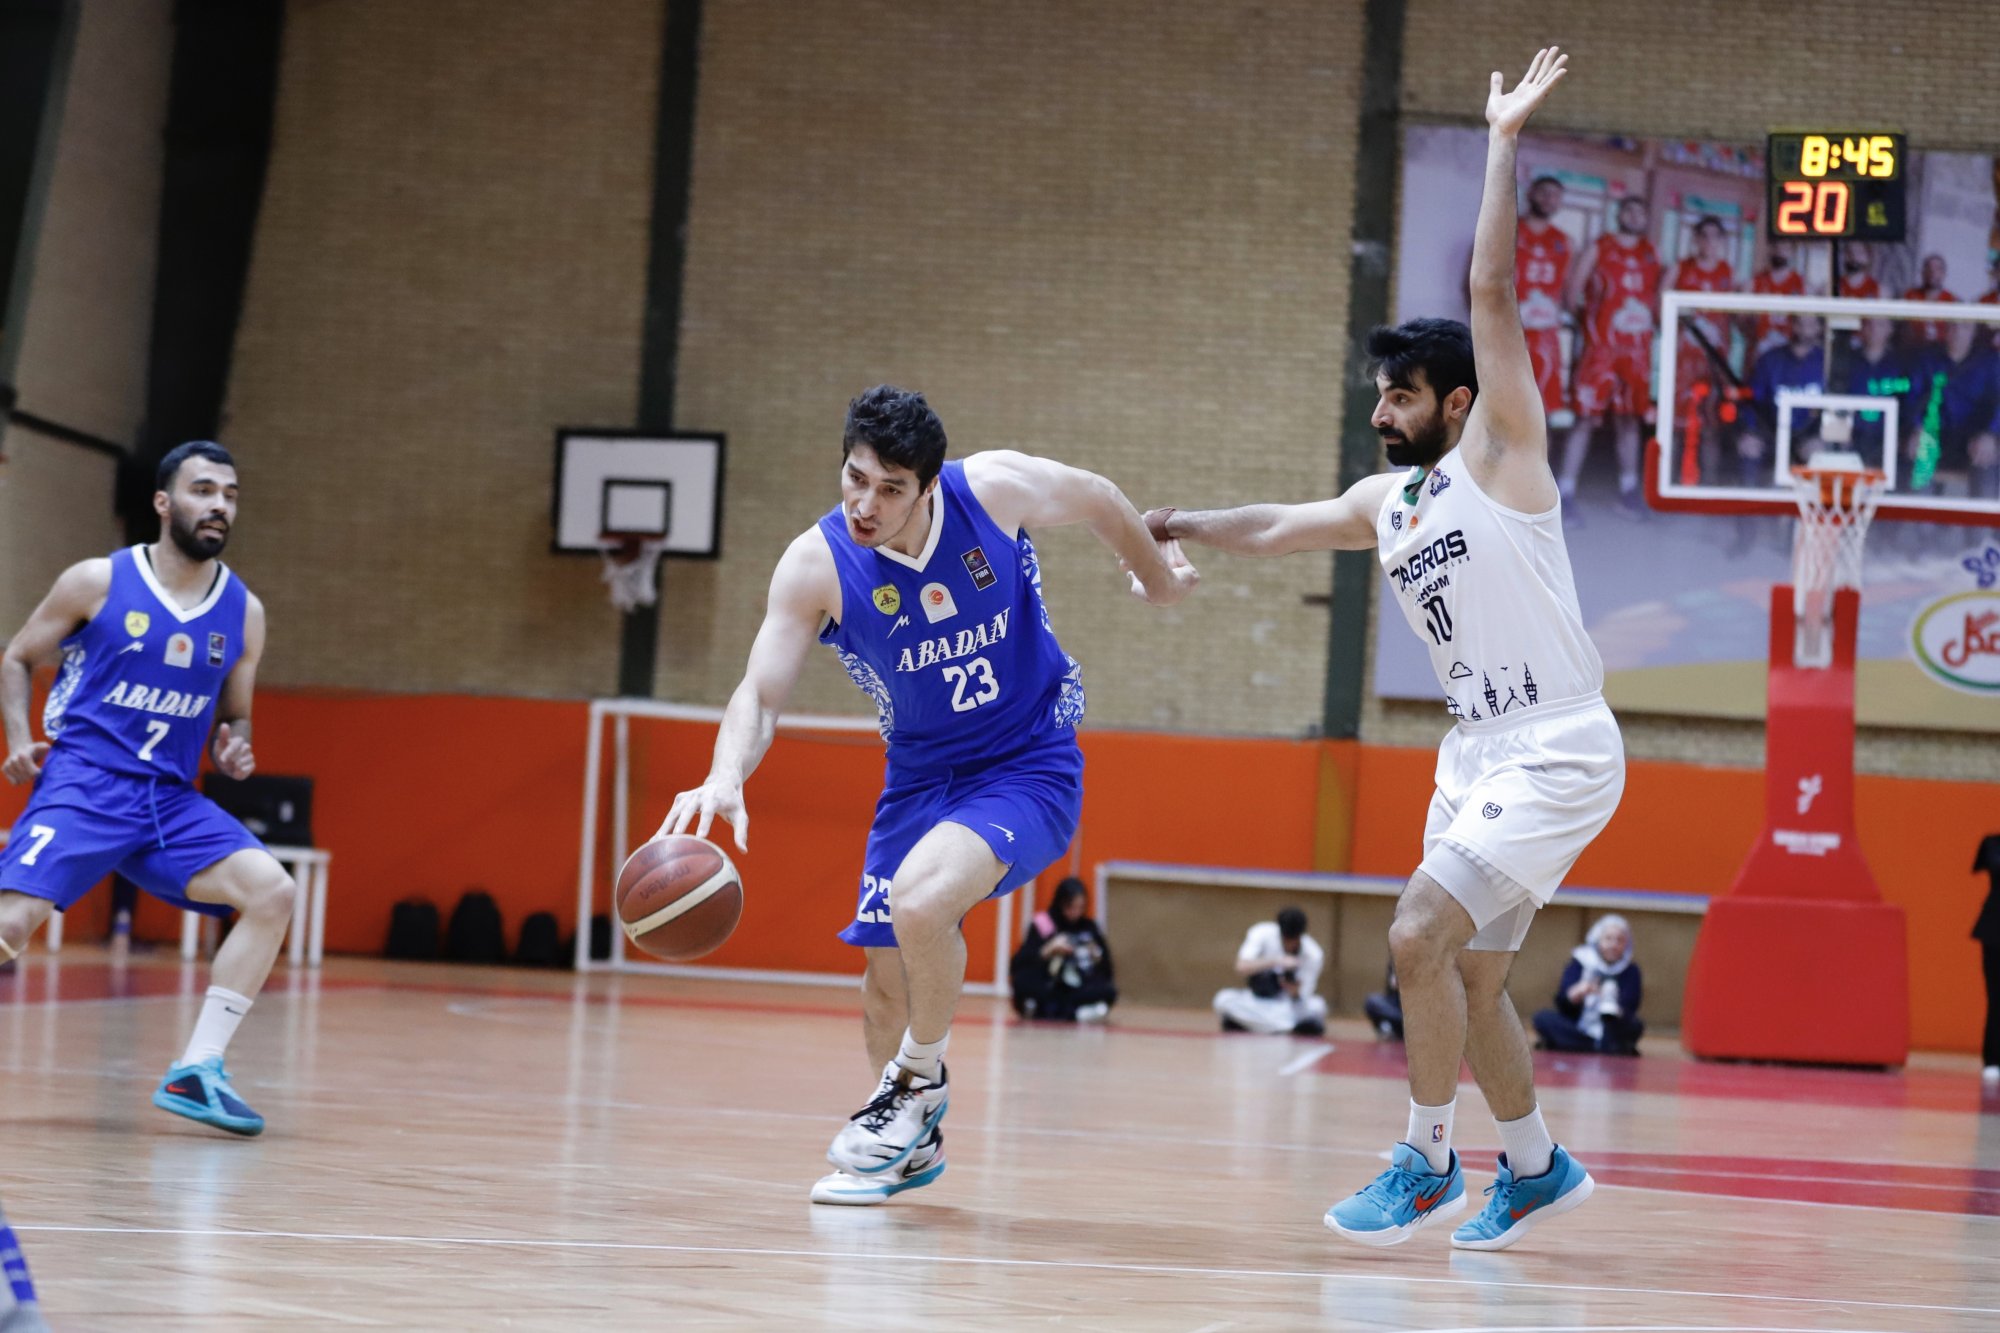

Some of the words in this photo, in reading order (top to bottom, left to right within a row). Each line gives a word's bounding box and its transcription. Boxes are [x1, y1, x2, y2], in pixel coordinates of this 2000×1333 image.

[1801, 135, 1894, 177] 8:45
[1778, 181, 1849, 233] 20
[974, 568, 990, 581] FIBA
[895, 606, 1011, 672] ABADAN
[1422, 595, 1453, 646] 10
[101, 680, 212, 718] ABADAN
[941, 656, 1000, 713] 23
[138, 719, 171, 762] 7
[20, 824, 57, 866] 7
[856, 873, 894, 924] 23
